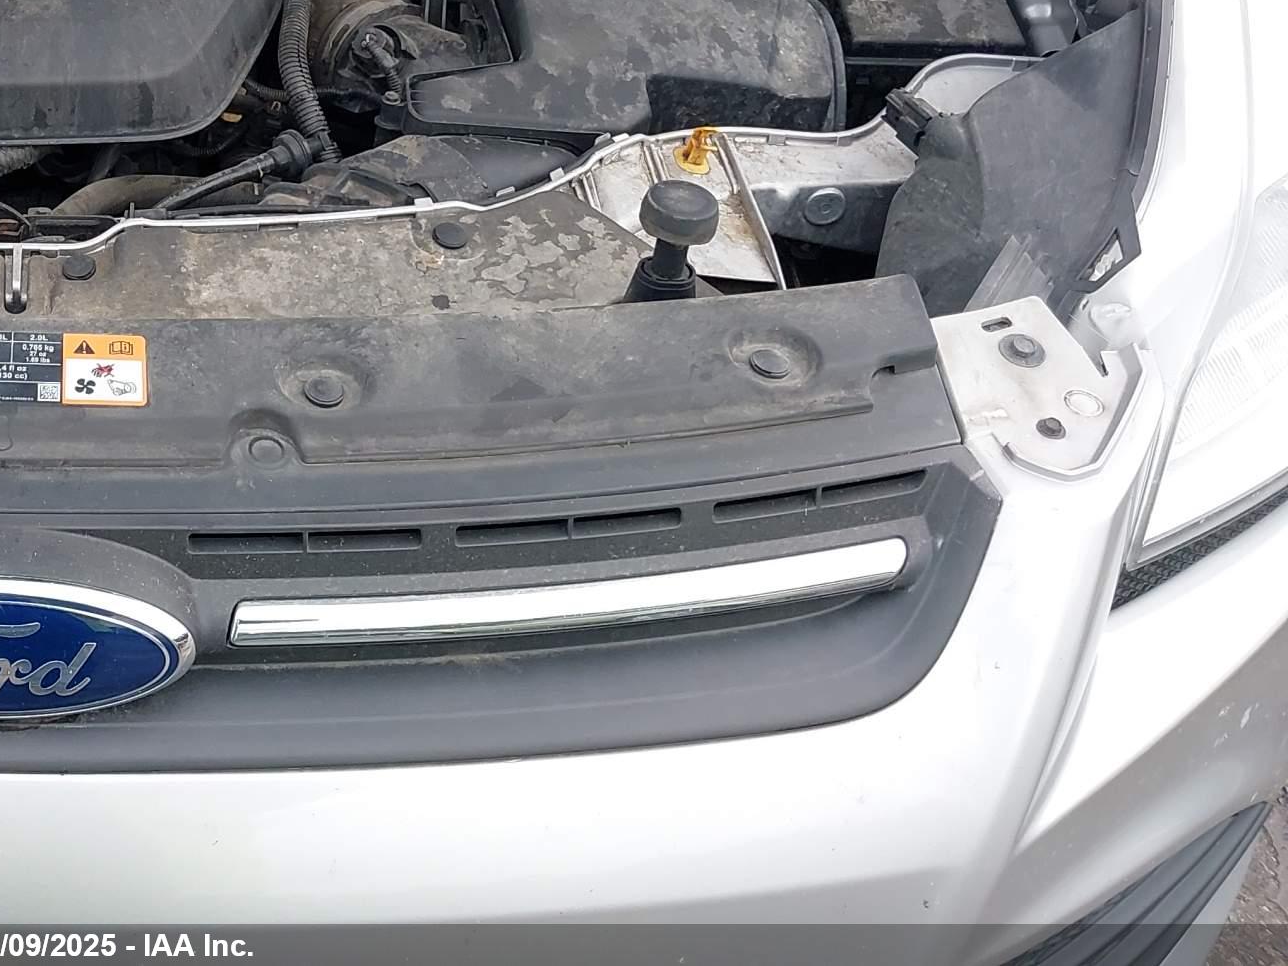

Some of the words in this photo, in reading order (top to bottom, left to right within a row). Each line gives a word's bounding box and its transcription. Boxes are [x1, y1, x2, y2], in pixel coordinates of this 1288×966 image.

[44, 344, 55, 353] kg
[8, 364, 15, 372] fl
[14, 372, 28, 380] cc)
